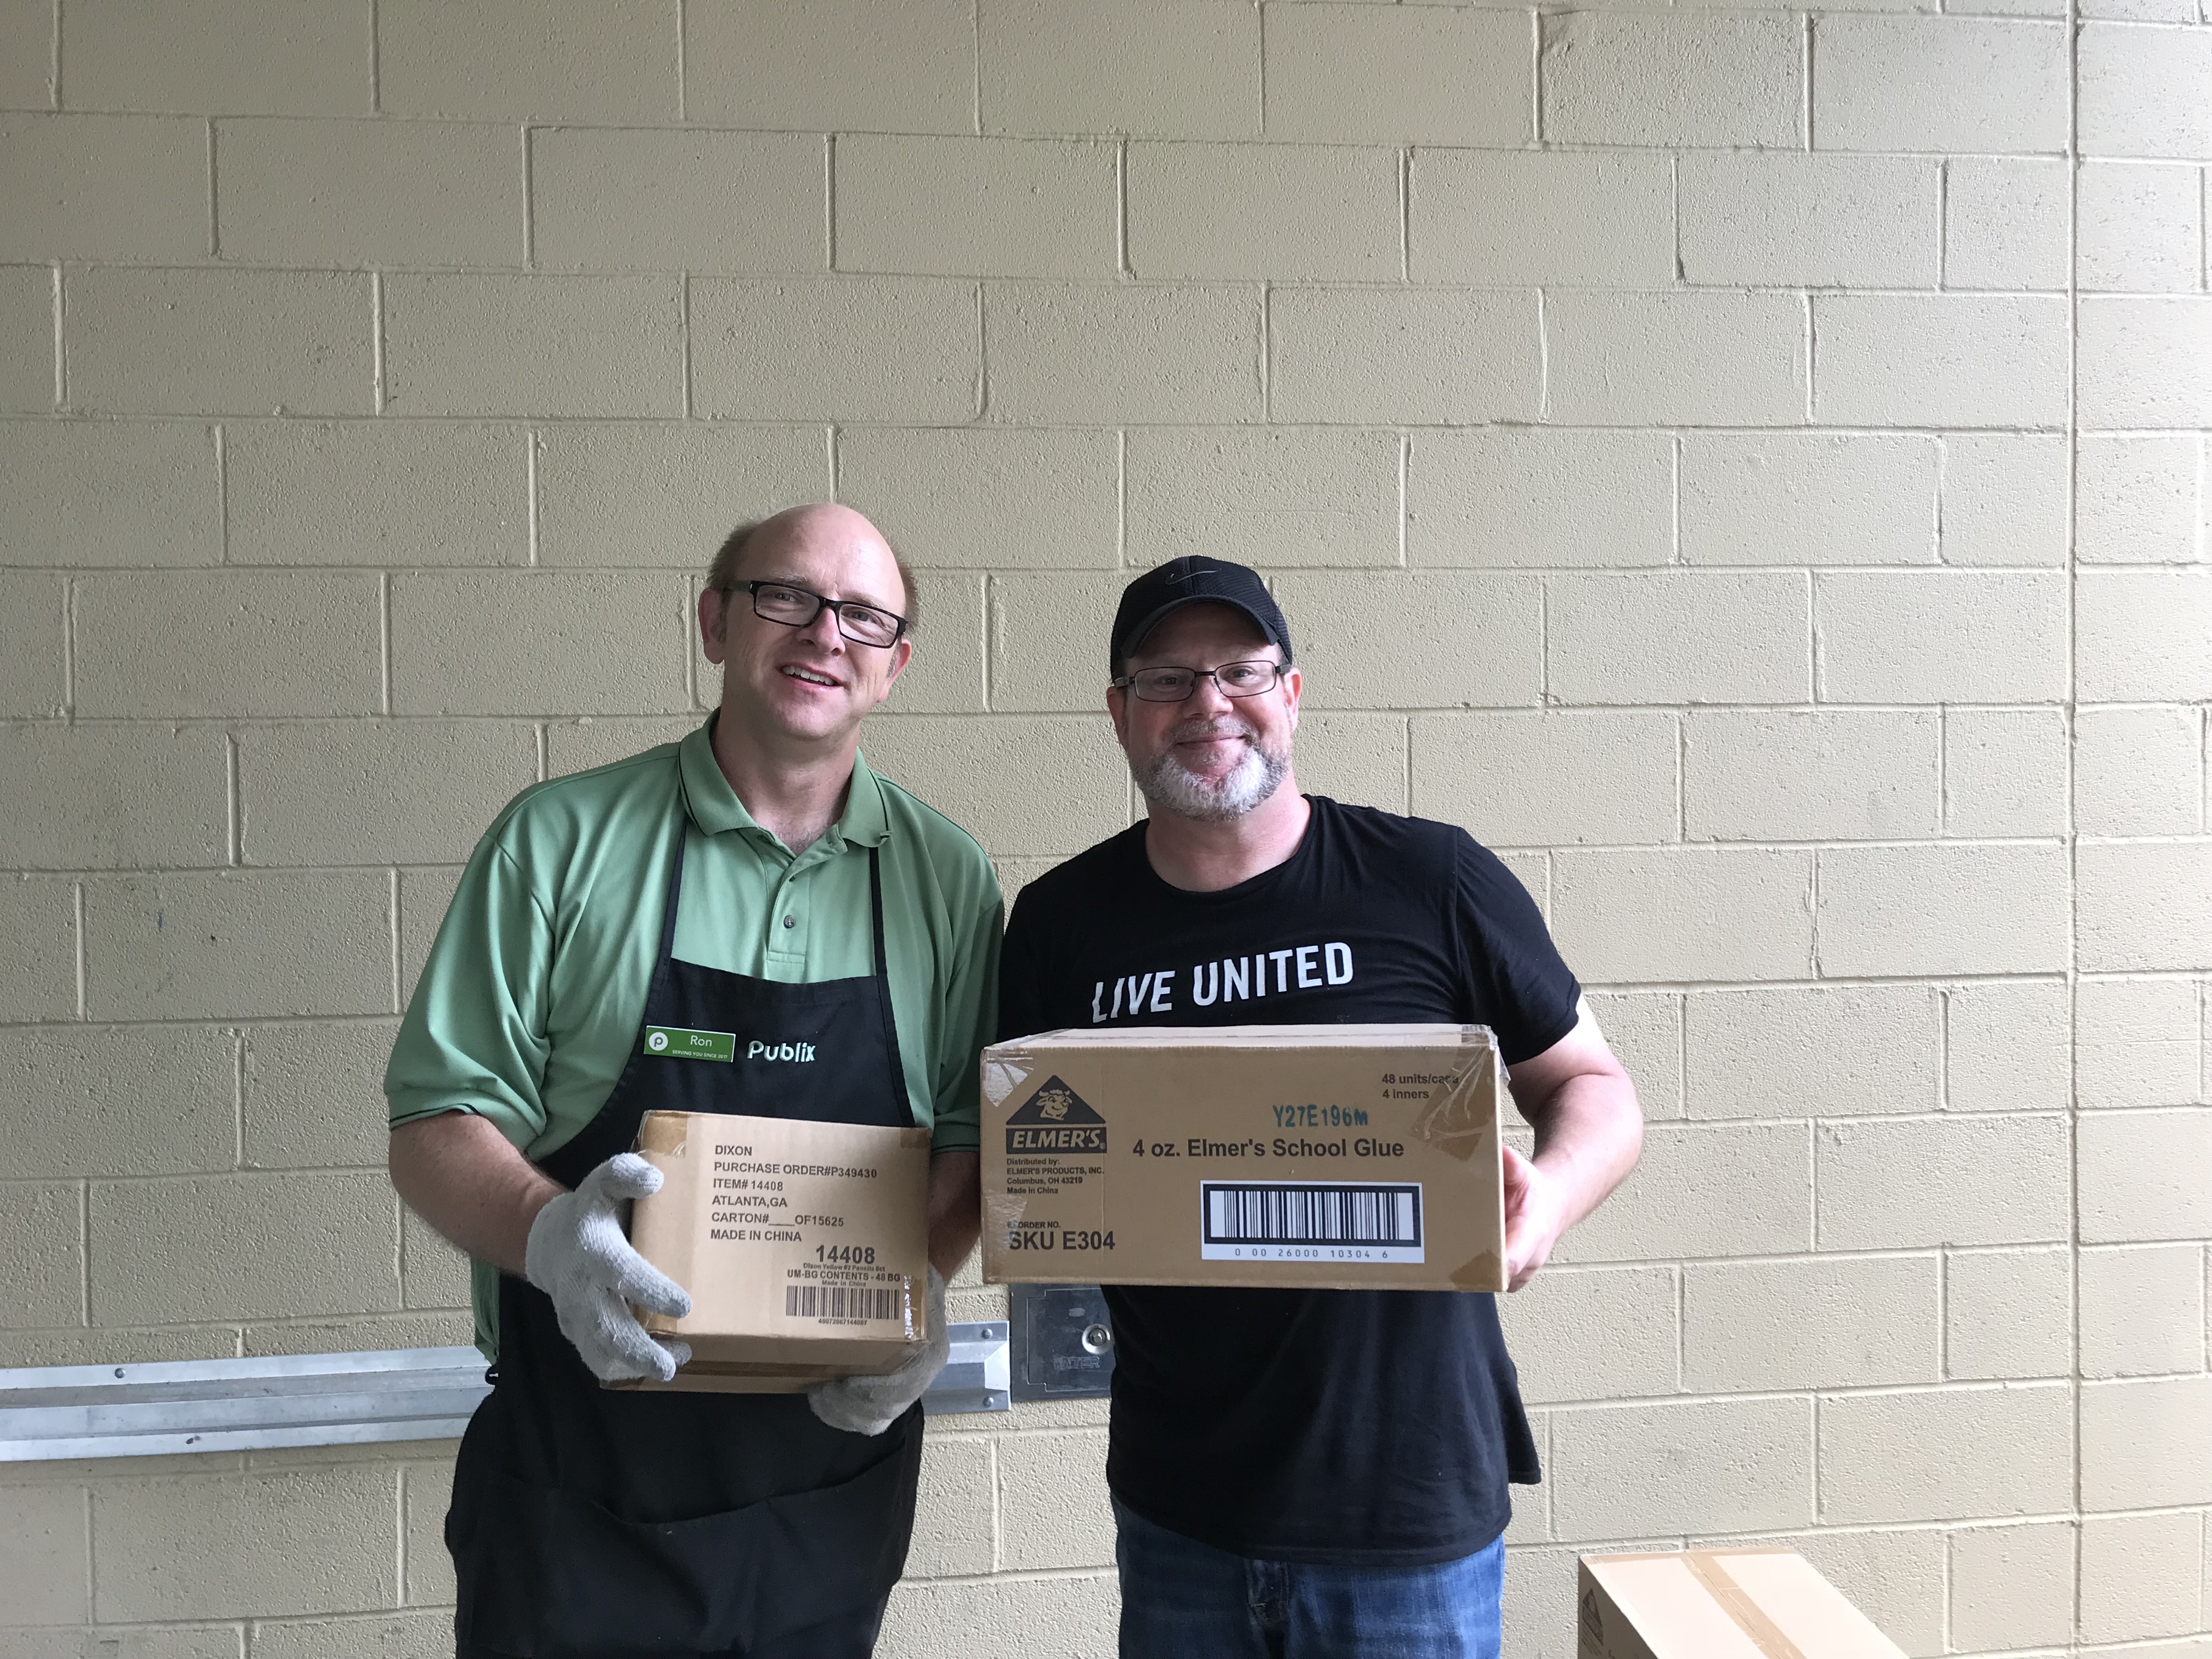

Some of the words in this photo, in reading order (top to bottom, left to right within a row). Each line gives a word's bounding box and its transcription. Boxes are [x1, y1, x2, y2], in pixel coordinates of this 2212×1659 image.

[1092, 970, 1176, 1023] LIVE
[1193, 941, 1354, 1006] UNITED
[690, 1035, 712, 1047] Ron
[747, 1040, 816, 1062] Publix
[1381, 1073, 1396, 1084] 48
[1383, 1089, 1390, 1099] 4
[1392, 1088, 1430, 1099] inners
[1012, 1130, 1101, 1148] ELMER'S
[715, 1145, 752, 1156] DIXON
[1133, 1139, 1145, 1156] 4
[1152, 1142, 1180, 1157] oz.
[1188, 1138, 1265, 1157] Elmer's
[1272, 1138, 1346, 1157] School
[1354, 1138, 1404, 1157] Glue
[1048, 1158, 1060, 1166] by:
[714, 1161, 780, 1173] PURCHASE
[783, 1164, 877, 1178] ORDER#P349430
[1042, 1167, 1087, 1175] PRODUCTS,
[713, 1178, 748, 1189] ITEM#
[751, 1180, 783, 1191] 14408
[710, 1229, 746, 1240] MADE
[749, 1230, 761, 1240] IN
[764, 1231, 802, 1242] CHINA
[1009, 1231, 1054, 1250] SKU
[1063, 1231, 1115, 1250] E304
[816, 1244, 875, 1265] 14408
[1278, 1249, 1318, 1257] 26000
[1330, 1250, 1370, 1258] 10304
[787, 1269, 818, 1279] UM-BG
[820, 1271, 869, 1280] CONTENTS
[876, 1273, 885, 1282] 48
[887, 1273, 901, 1282] BG
